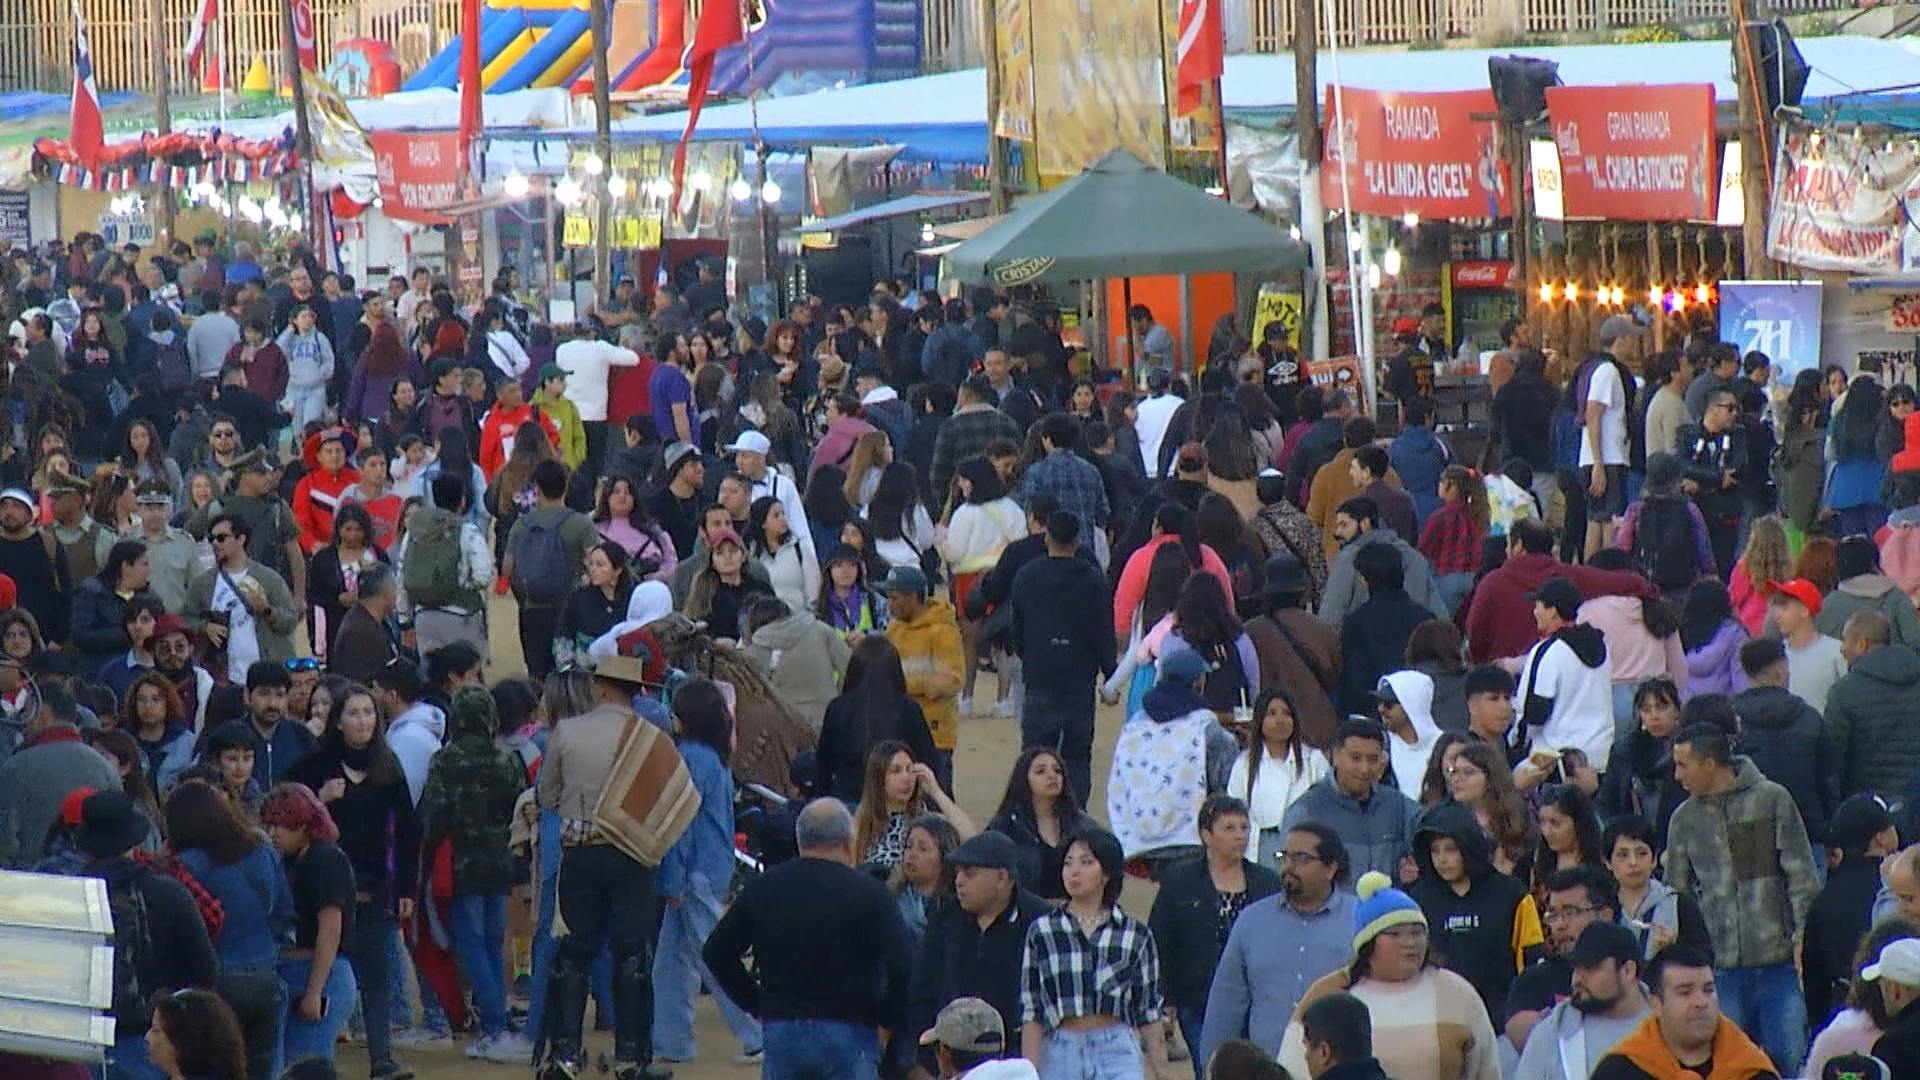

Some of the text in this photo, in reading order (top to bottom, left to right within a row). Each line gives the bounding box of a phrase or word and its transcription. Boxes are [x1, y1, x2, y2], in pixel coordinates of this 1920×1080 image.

[1385, 105, 1440, 140] RAMADA
[1607, 111, 1632, 141] GRAN
[1633, 111, 1672, 140] RAMADA
[1386, 161, 1426, 197] LINDA
